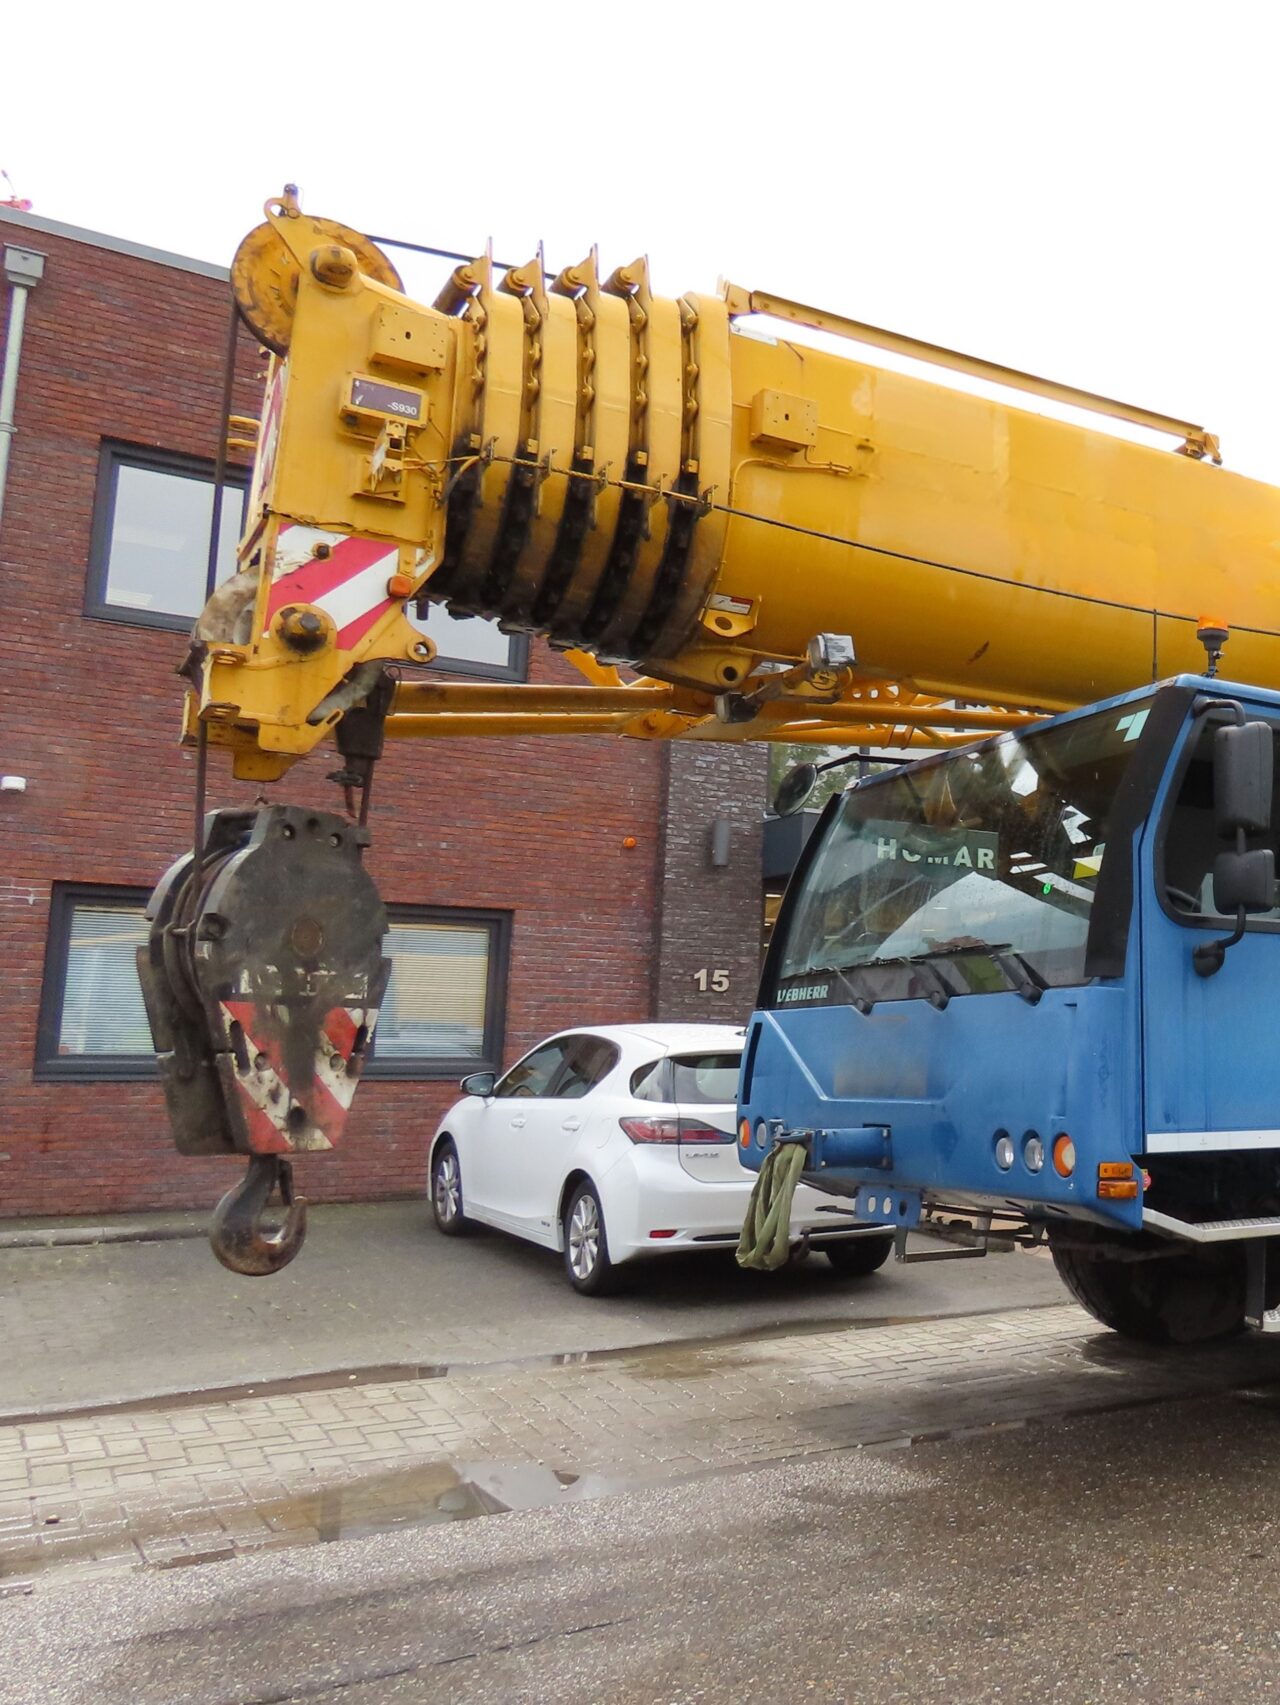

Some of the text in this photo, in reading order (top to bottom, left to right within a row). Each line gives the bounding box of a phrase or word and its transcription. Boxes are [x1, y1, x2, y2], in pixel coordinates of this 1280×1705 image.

[387, 401, 417, 416] -S930
[693, 968, 730, 992] 15
[776, 984, 829, 1003] LIEBHERR
